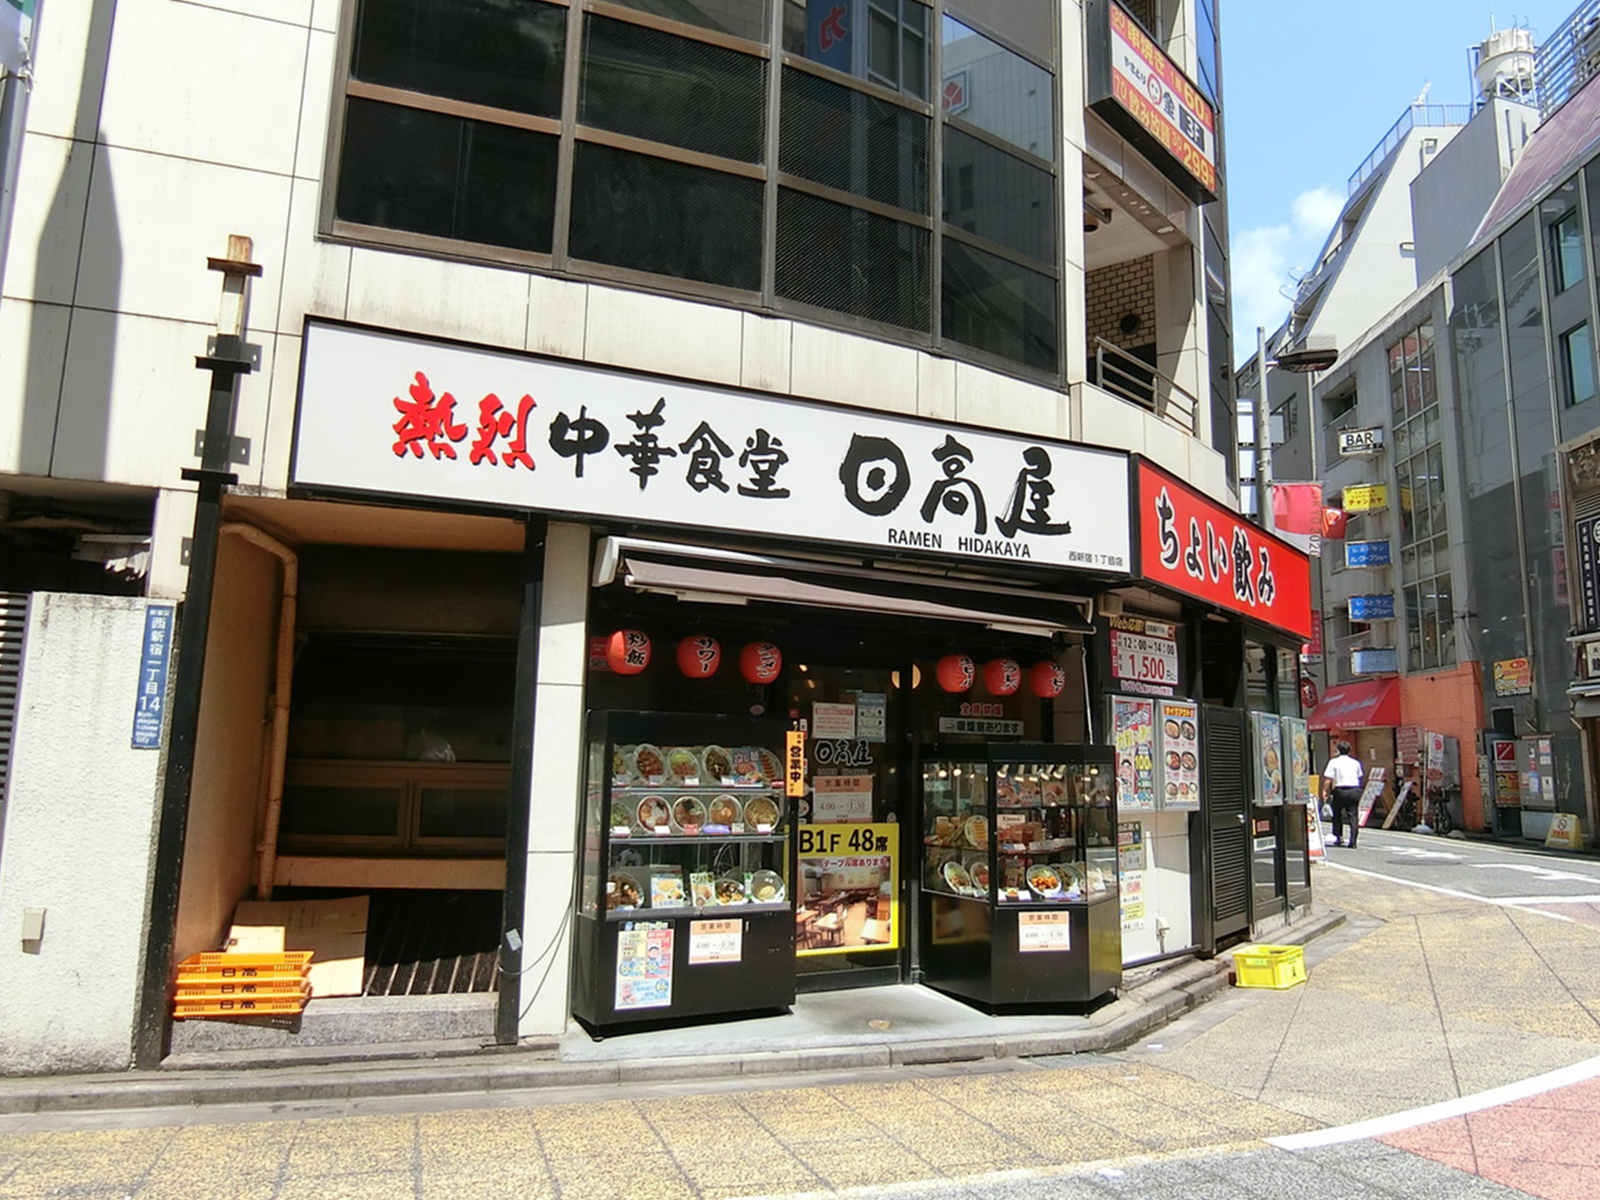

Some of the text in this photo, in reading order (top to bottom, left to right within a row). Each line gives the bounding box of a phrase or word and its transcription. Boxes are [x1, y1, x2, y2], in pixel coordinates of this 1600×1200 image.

[1185, 115, 1201, 143] 3F
[1345, 432, 1374, 446] BAR
[839, 432, 1072, 538] 日高屋
[888, 528, 1031, 559] RAMEN HIDAKAYA
[1155, 486, 1276, 607] ちょい飲み
[145, 617, 167, 695] 西新宿一丁目
[626, 632, 649, 667] 炒飯
[694, 637, 716, 673] サワー
[140, 696, 161, 711] 14
[799, 829, 842, 853] B1F
